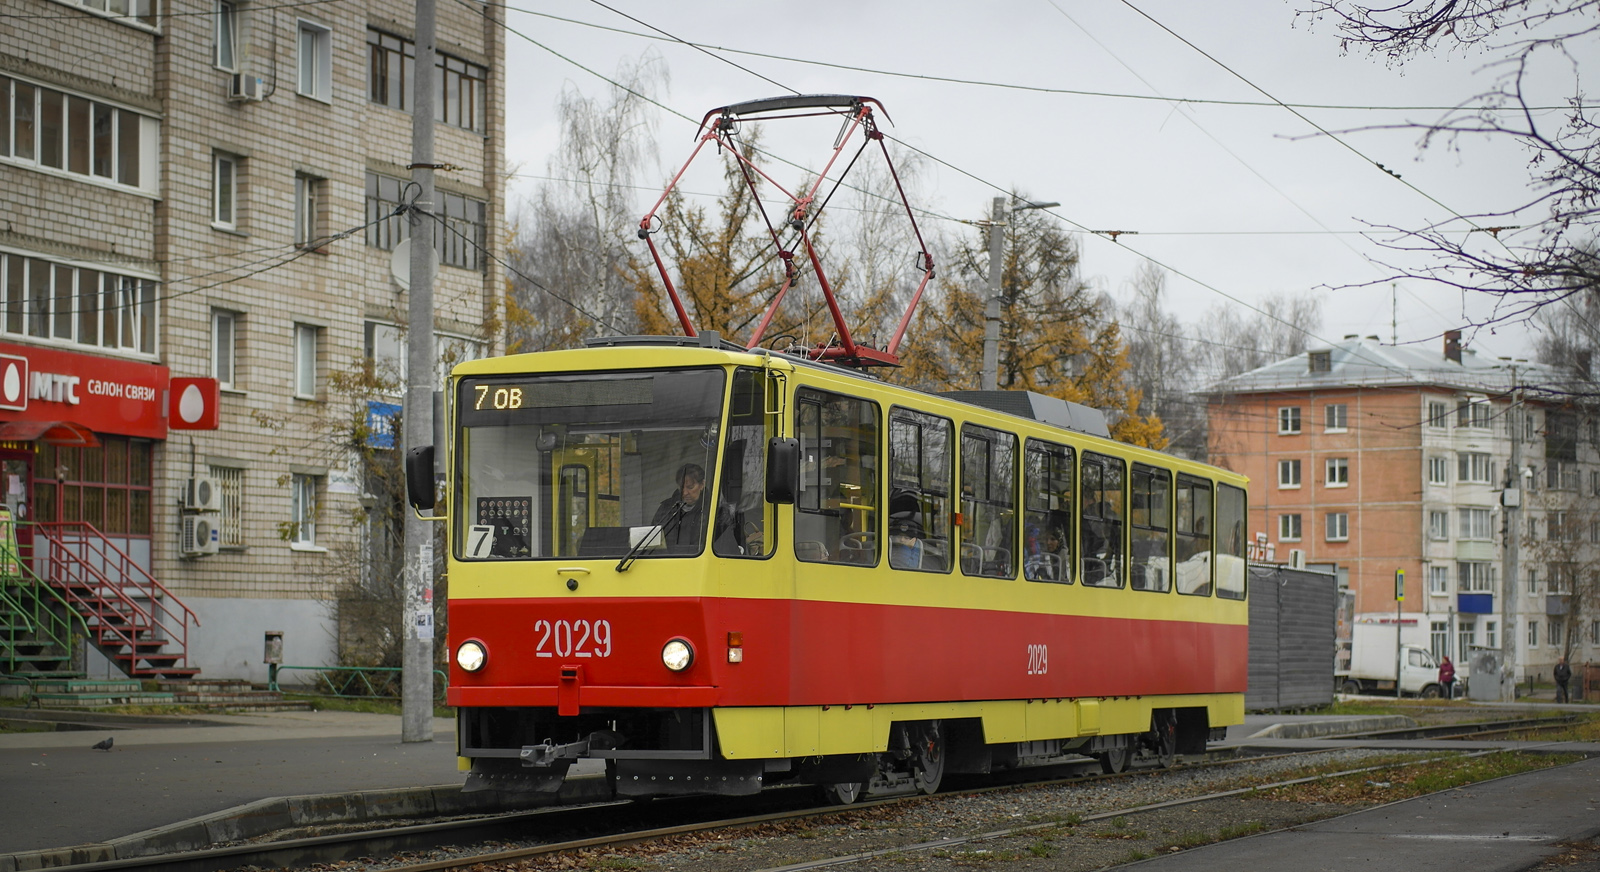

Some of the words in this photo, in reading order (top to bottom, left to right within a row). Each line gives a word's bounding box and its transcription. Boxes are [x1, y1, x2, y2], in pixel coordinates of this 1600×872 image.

[31, 371, 80, 405] МТС
[88, 379, 123, 397] салон
[125, 384, 155, 401] связи
[475, 385, 489, 410] 7
[473, 527, 490, 556] 7
[534, 619, 612, 658] 2029
[1027, 644, 1048, 674] 2029
